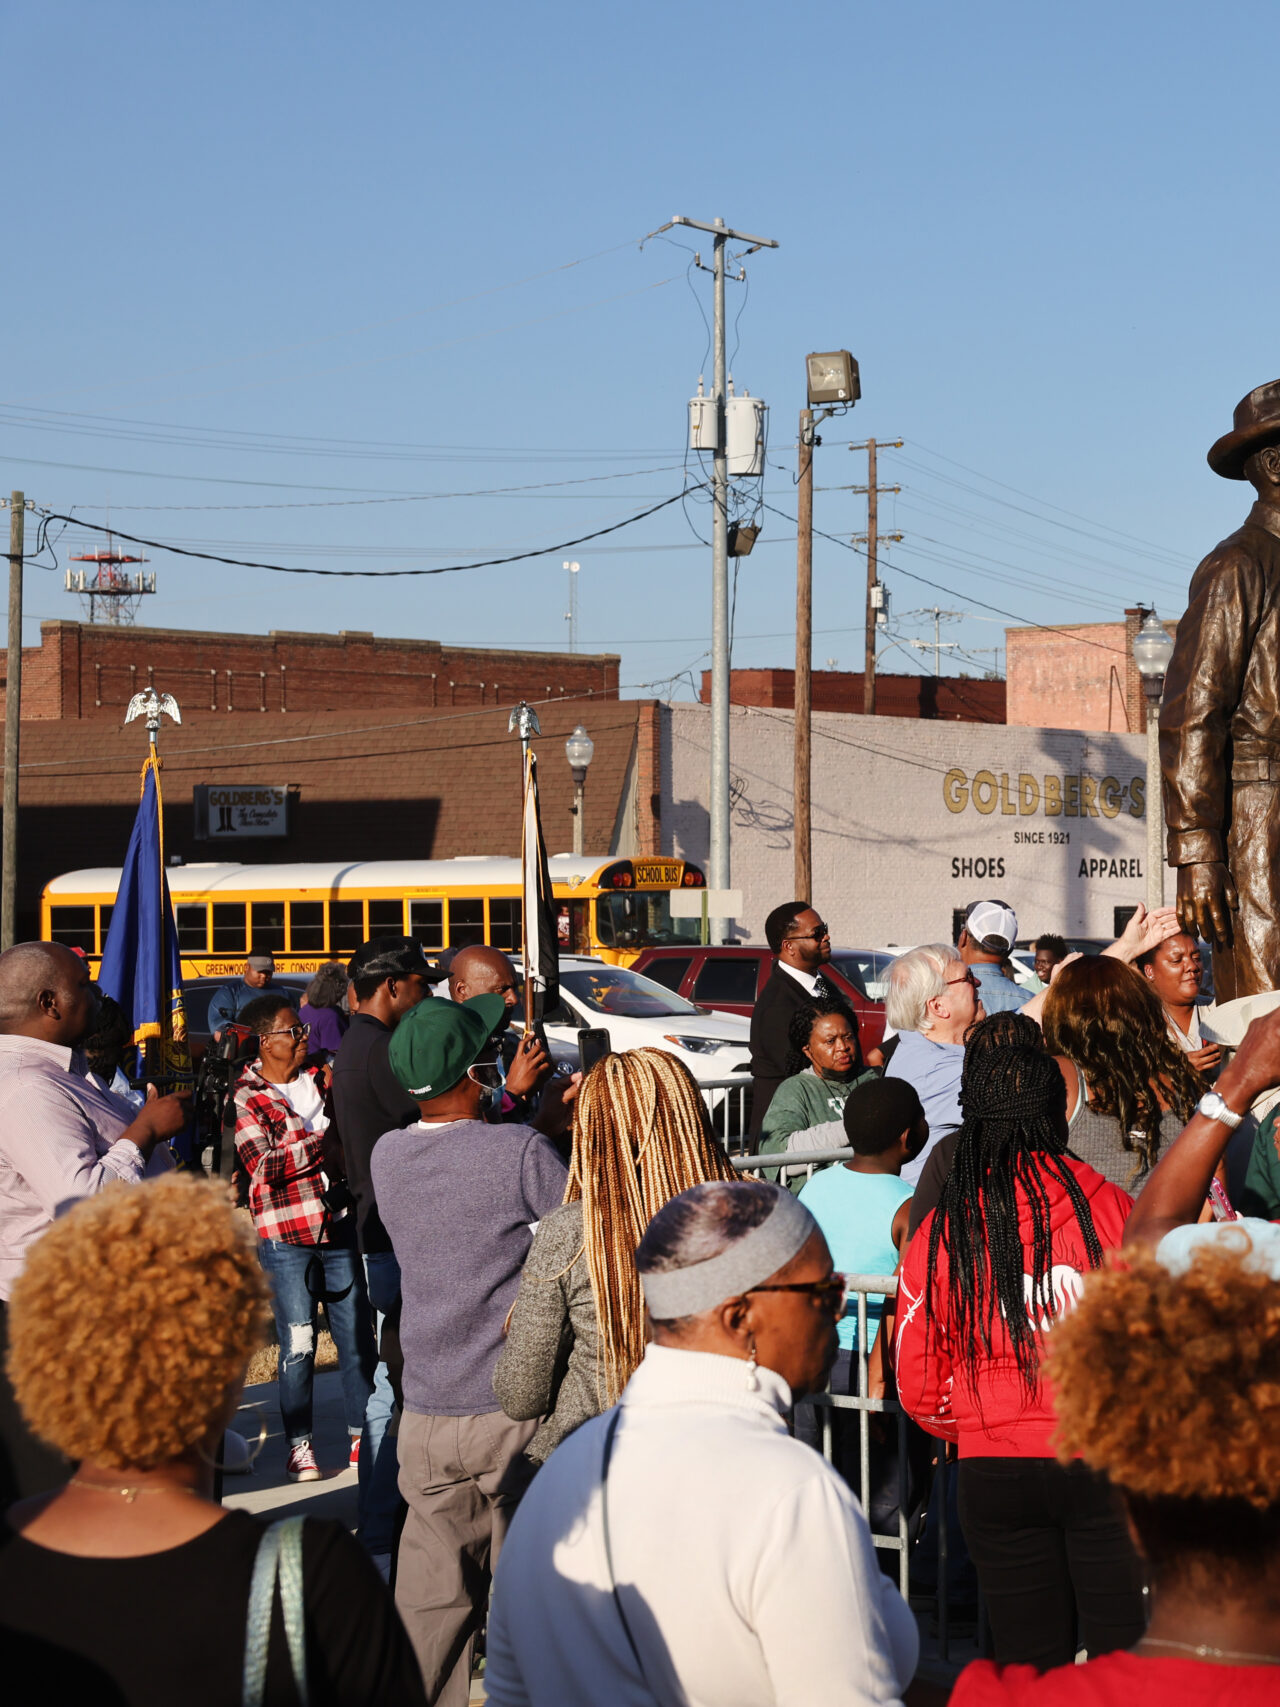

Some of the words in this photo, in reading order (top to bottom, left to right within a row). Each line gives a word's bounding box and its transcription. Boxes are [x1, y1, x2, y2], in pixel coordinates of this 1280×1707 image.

[210, 789, 283, 806] GOLDBERG'S
[943, 768, 1146, 819] GOLDBERG'S
[1014, 832, 1045, 844] SINCE
[1048, 832, 1070, 844] 1921
[637, 867, 663, 882] SCHOOL
[665, 867, 678, 882] BUS
[951, 857, 1005, 879] SHOES
[1078, 858, 1143, 878] APPAREL
[291, 962, 321, 973] CONSOL
